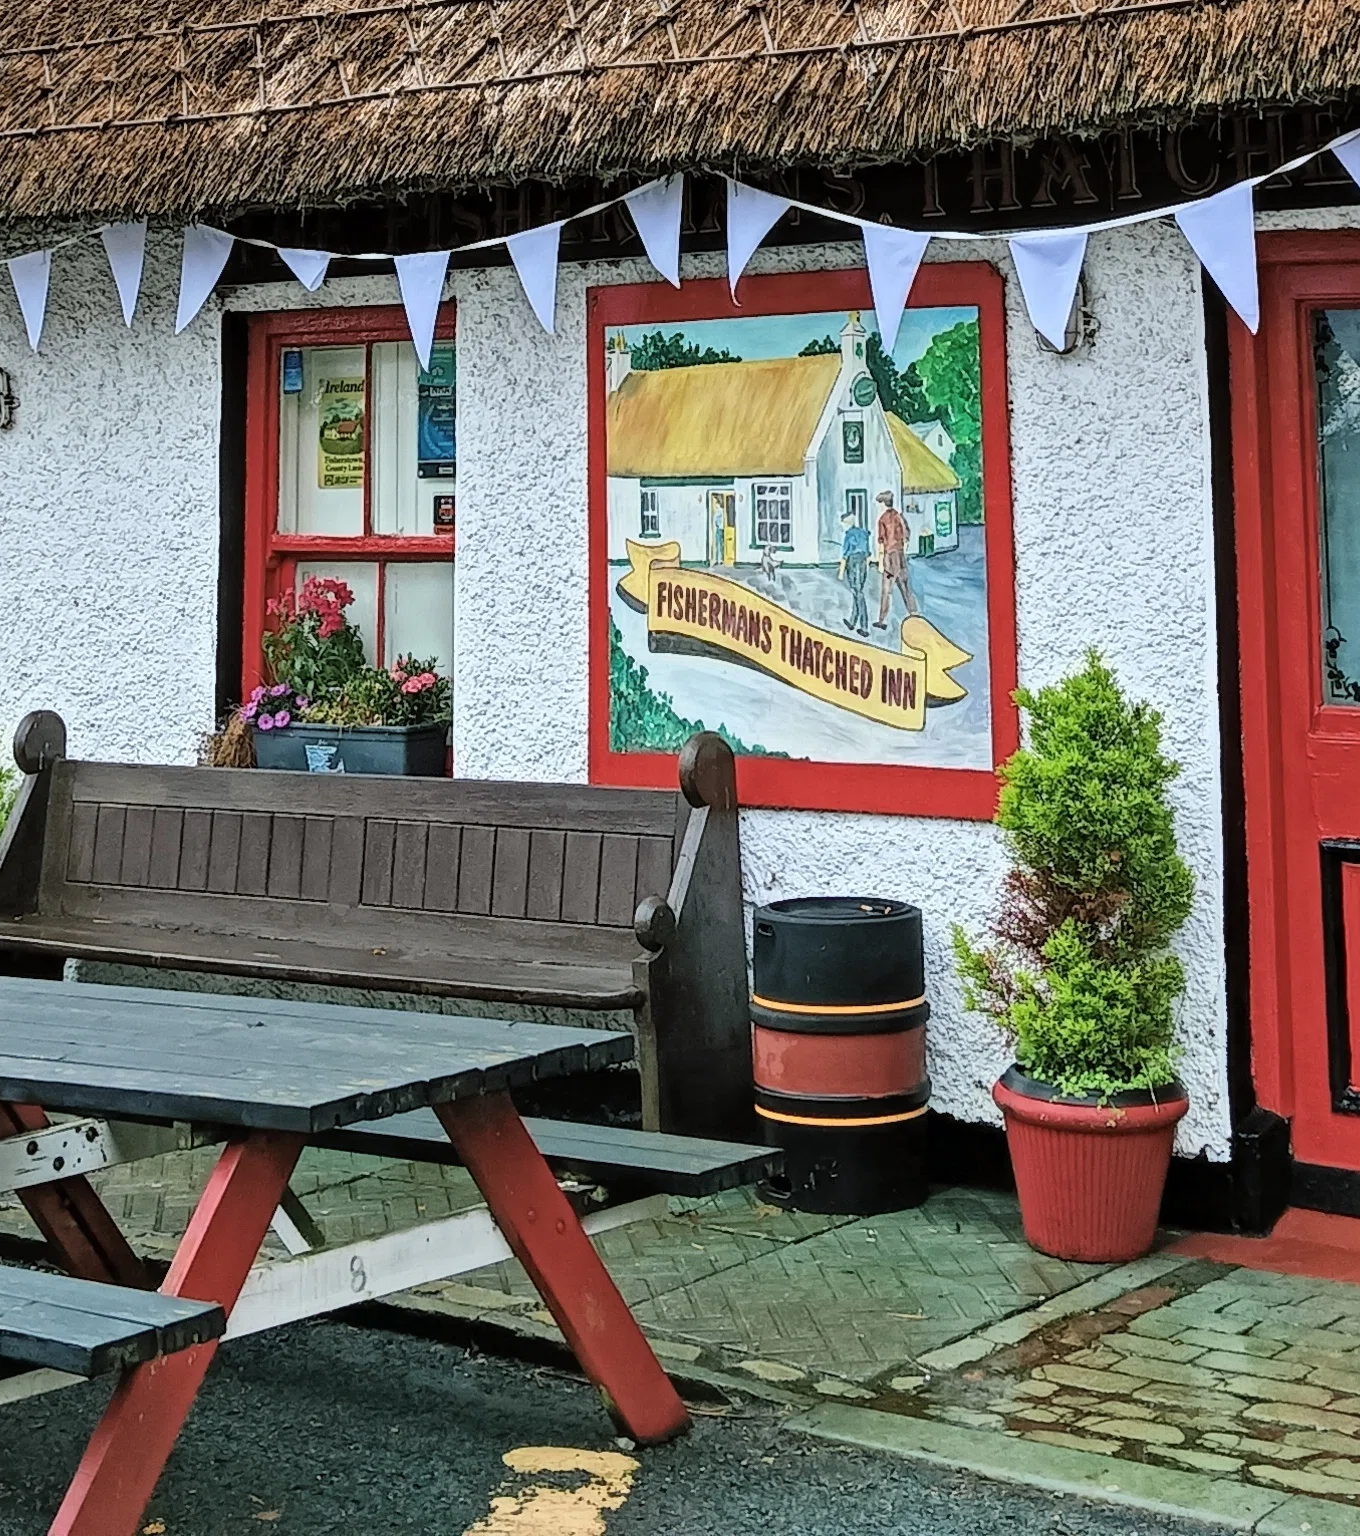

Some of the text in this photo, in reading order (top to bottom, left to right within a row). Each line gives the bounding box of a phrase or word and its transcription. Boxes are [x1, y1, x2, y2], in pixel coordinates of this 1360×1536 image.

[324, 379, 365, 394] Ireland
[656, 580, 917, 710] FISHERMANS THATCHED INN
